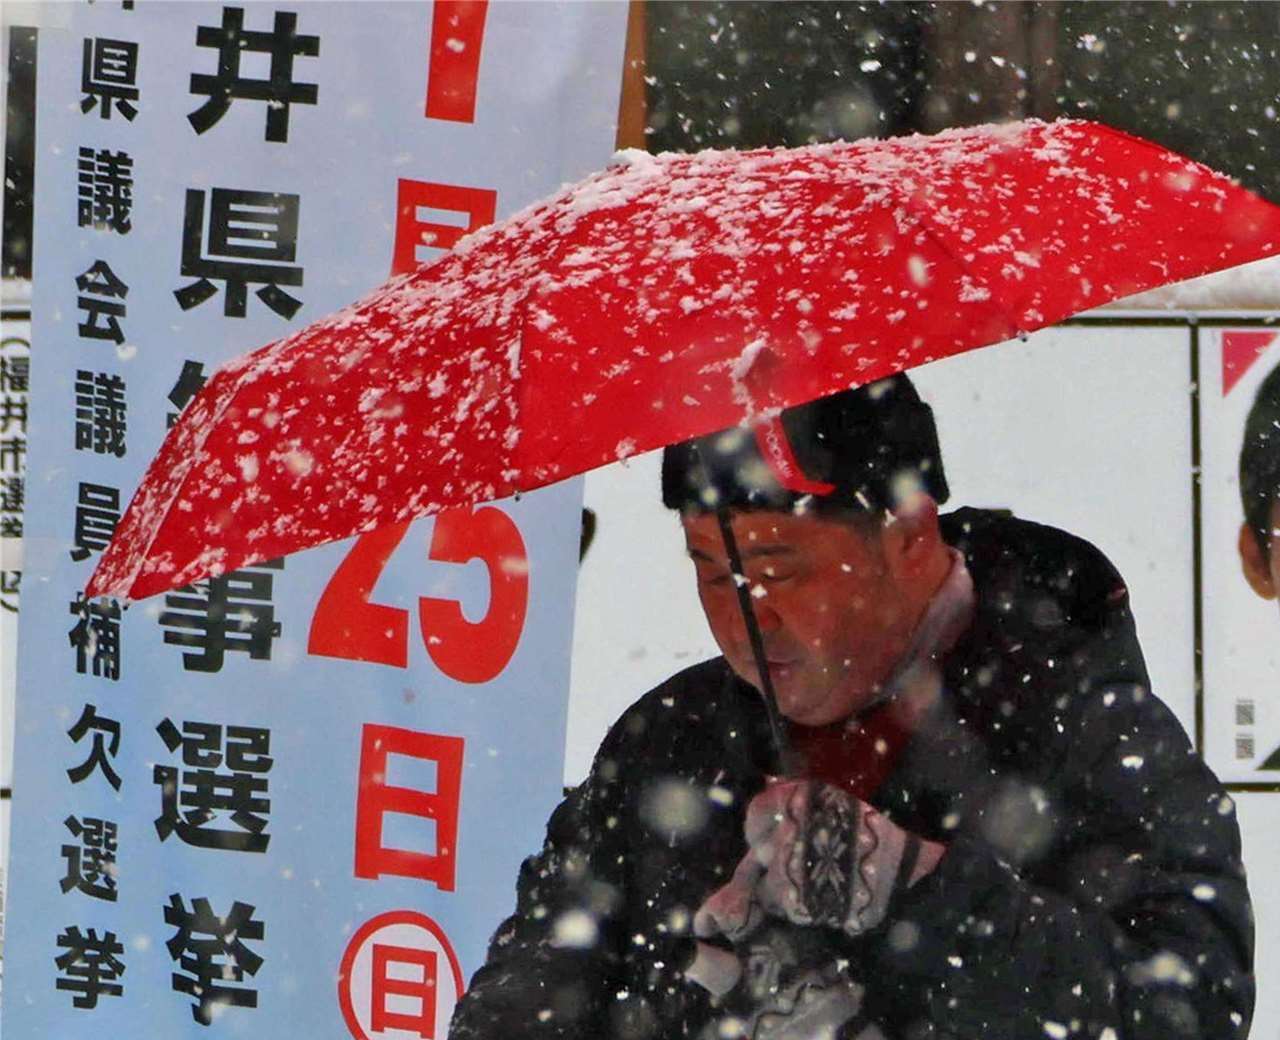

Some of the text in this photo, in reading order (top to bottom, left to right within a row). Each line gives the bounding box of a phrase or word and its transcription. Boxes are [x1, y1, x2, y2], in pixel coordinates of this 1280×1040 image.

[54, 0, 140, 1010] 県議会議員補欠選挙
[153, 6, 320, 1026] 井県事選挙
